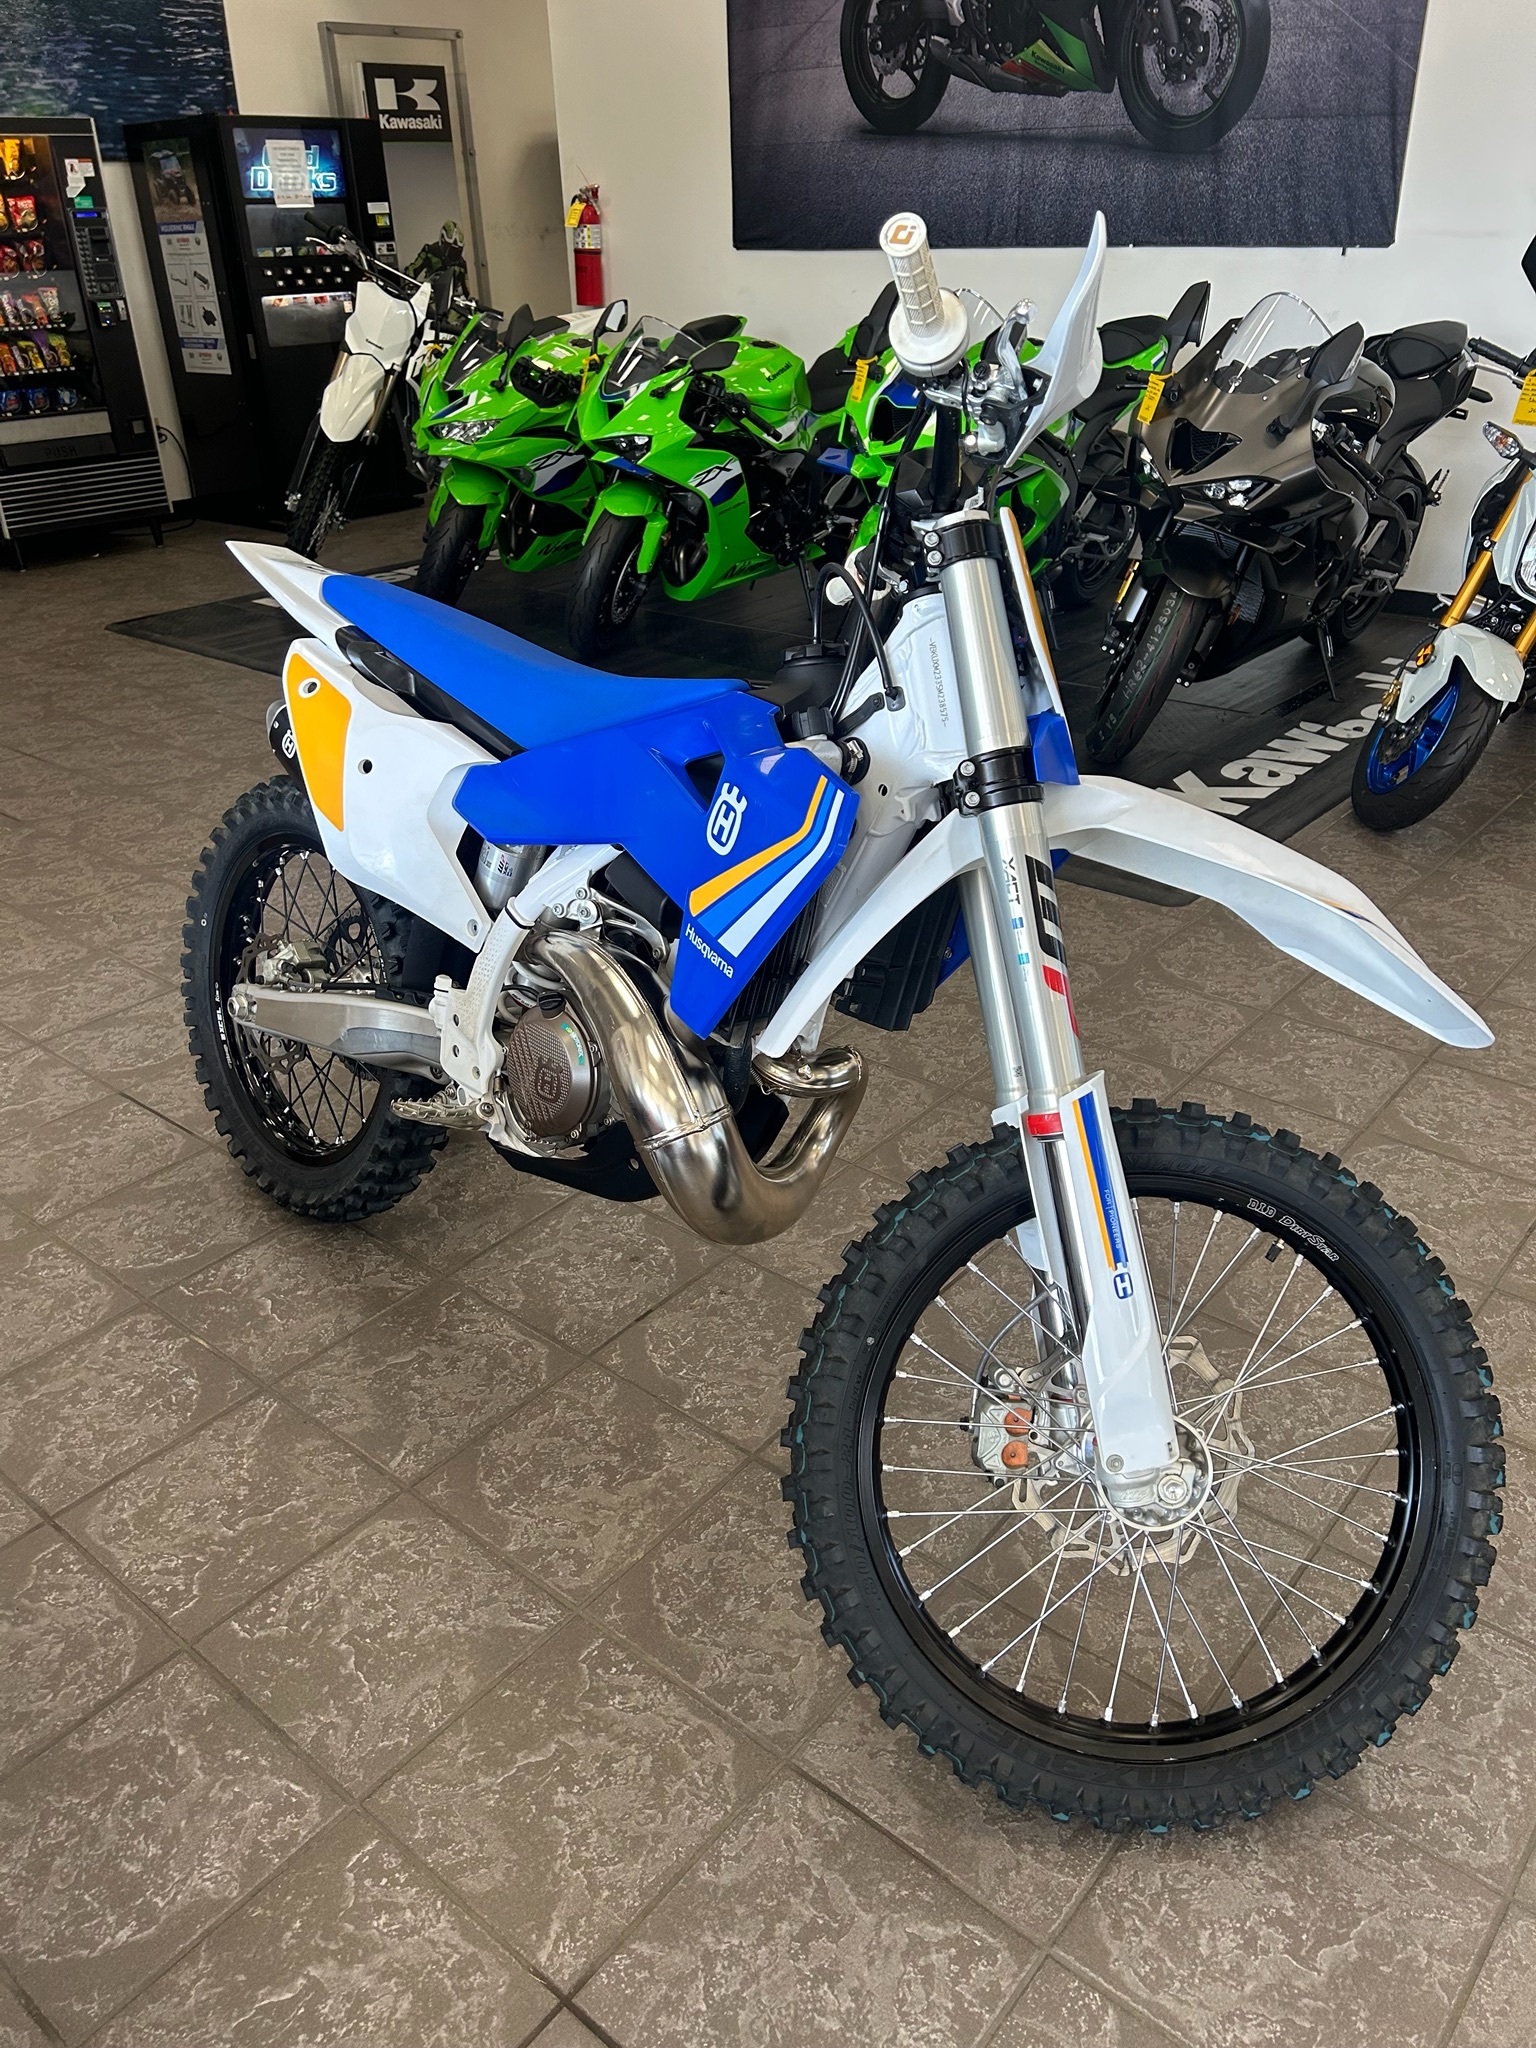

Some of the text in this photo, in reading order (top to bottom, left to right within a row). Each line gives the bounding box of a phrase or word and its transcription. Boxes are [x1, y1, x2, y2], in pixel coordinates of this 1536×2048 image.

[379, 113, 443, 130] Kawasaki
[251, 166, 337, 192] Dks
[766, 361, 793, 383] Kawasaki
[685, 923, 734, 979] Husqvarna
